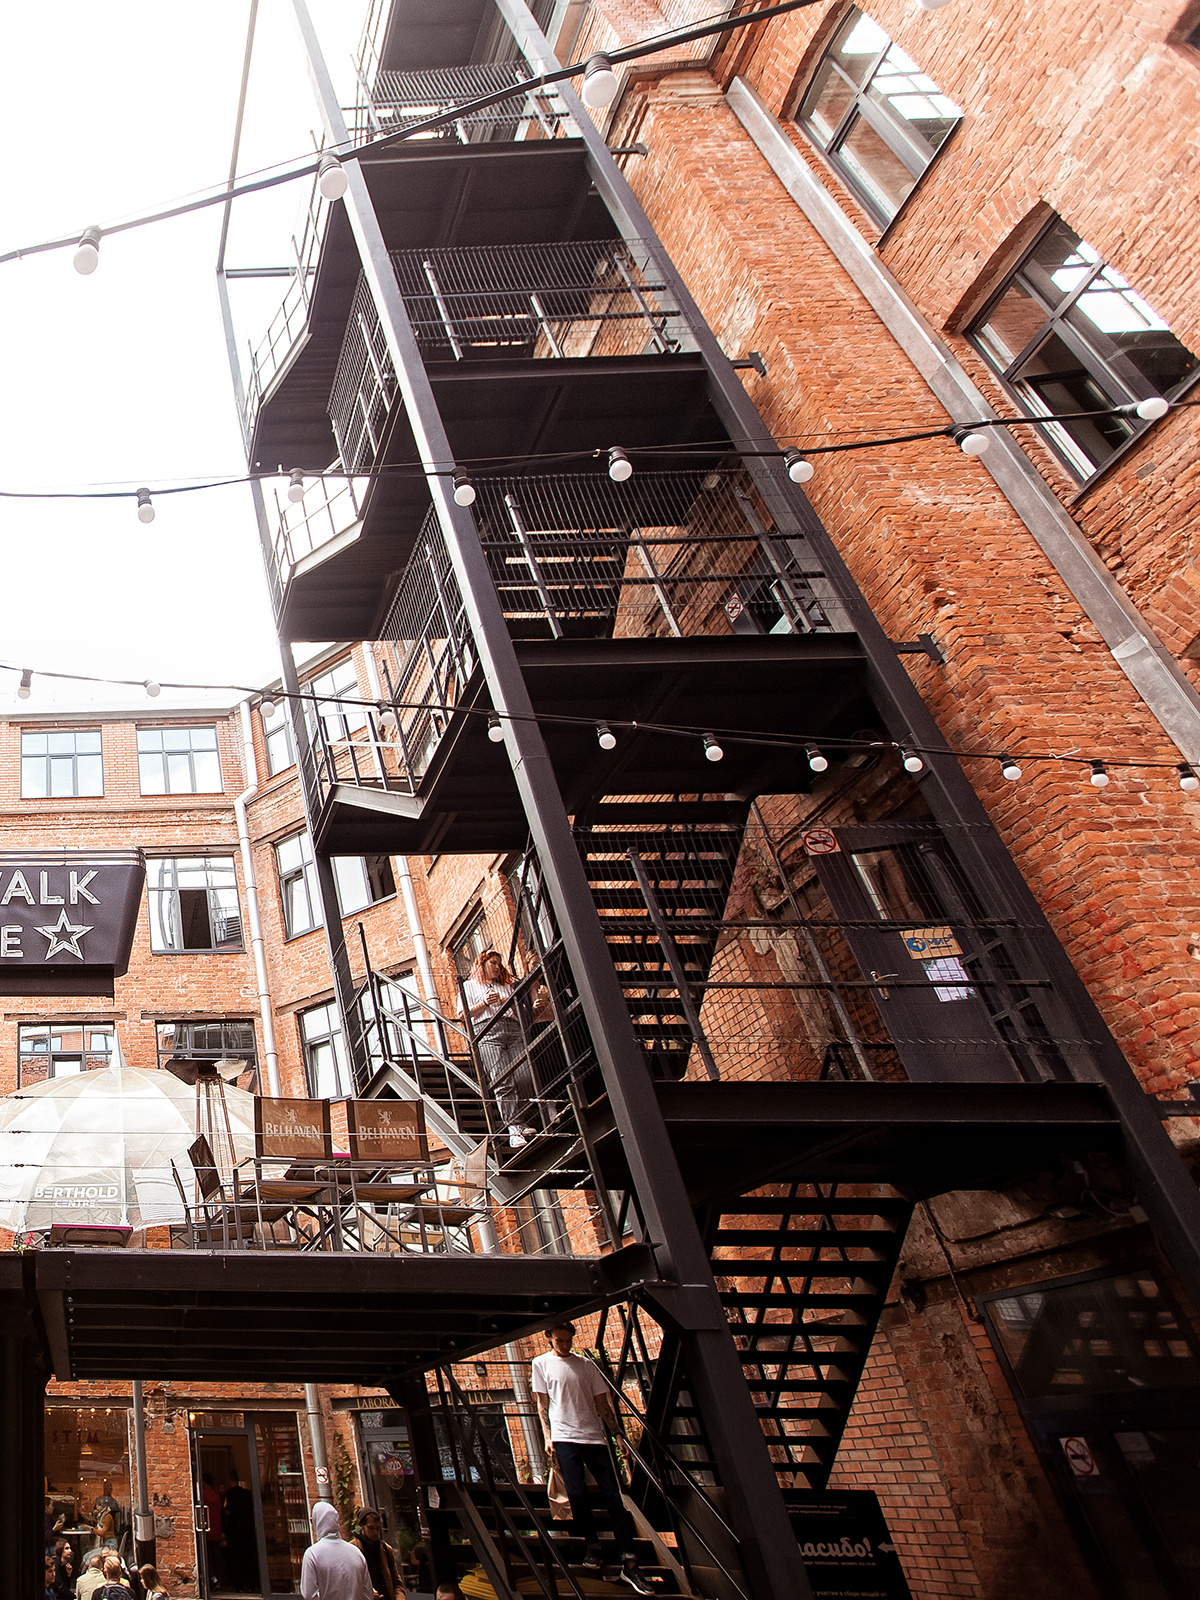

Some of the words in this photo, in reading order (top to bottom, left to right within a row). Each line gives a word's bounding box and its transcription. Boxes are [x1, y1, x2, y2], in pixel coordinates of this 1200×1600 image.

[265, 1122, 321, 1140] BELHAVEN
[358, 1125, 416, 1141] BELHAVEN
[34, 1186, 119, 1199] BERTHOLD
[55, 1199, 96, 1208] CENTRE
[356, 1396, 400, 1408] LABORA
